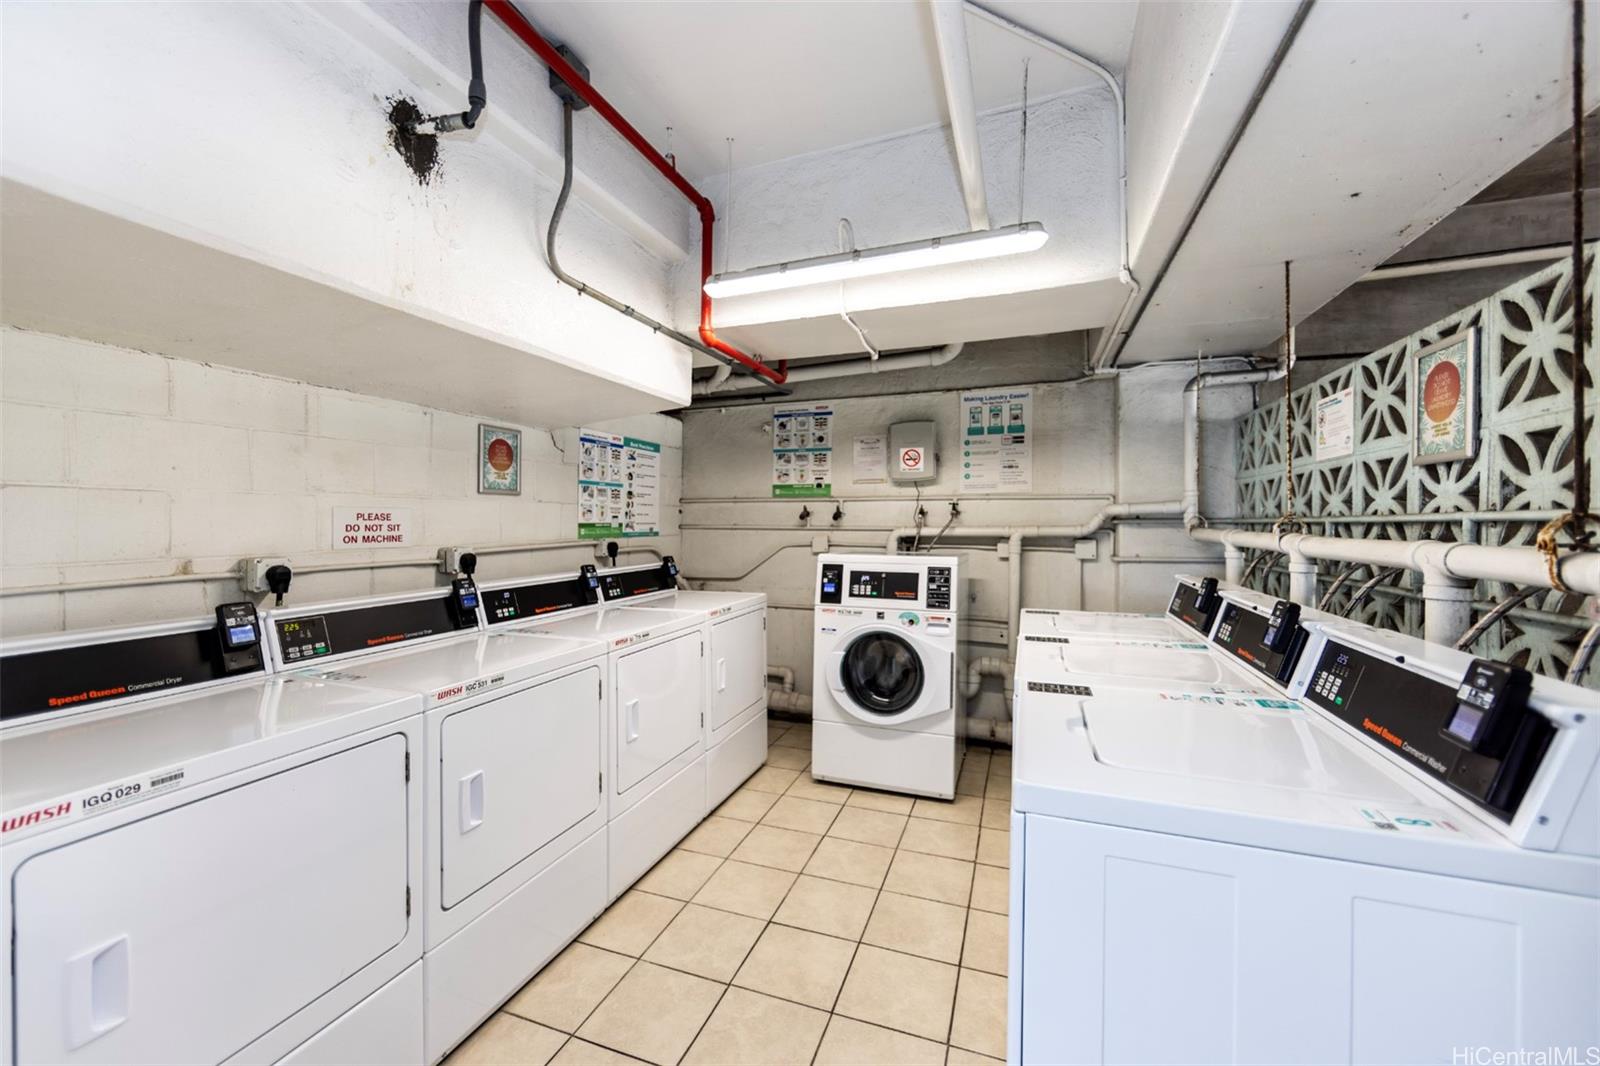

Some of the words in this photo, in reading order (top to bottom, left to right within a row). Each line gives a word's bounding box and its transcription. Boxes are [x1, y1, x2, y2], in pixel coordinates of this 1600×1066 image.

[356, 513, 392, 521] PLEASE
[345, 524, 360, 532] DO
[364, 524, 384, 532] NOT
[387, 524, 401, 532] SIT
[343, 535, 358, 544] ON
[362, 535, 403, 543] MACHINE
[48, 692, 87, 706] Speed
[89, 685, 126, 699] Queen
[128, 679, 164, 692] Commercial
[165, 676, 183, 686] Dryer
[437, 686, 463, 700] WASH
[1363, 718, 1383, 734] Speed
[1381, 728, 1403, 747] Queen
[1402, 741, 1428, 762] Commercial
[1427, 756, 1447, 773] Washer
[1, 801, 72, 833] WASH
[82, 792, 112, 809] IGQ
[115, 783, 141, 799] 029
